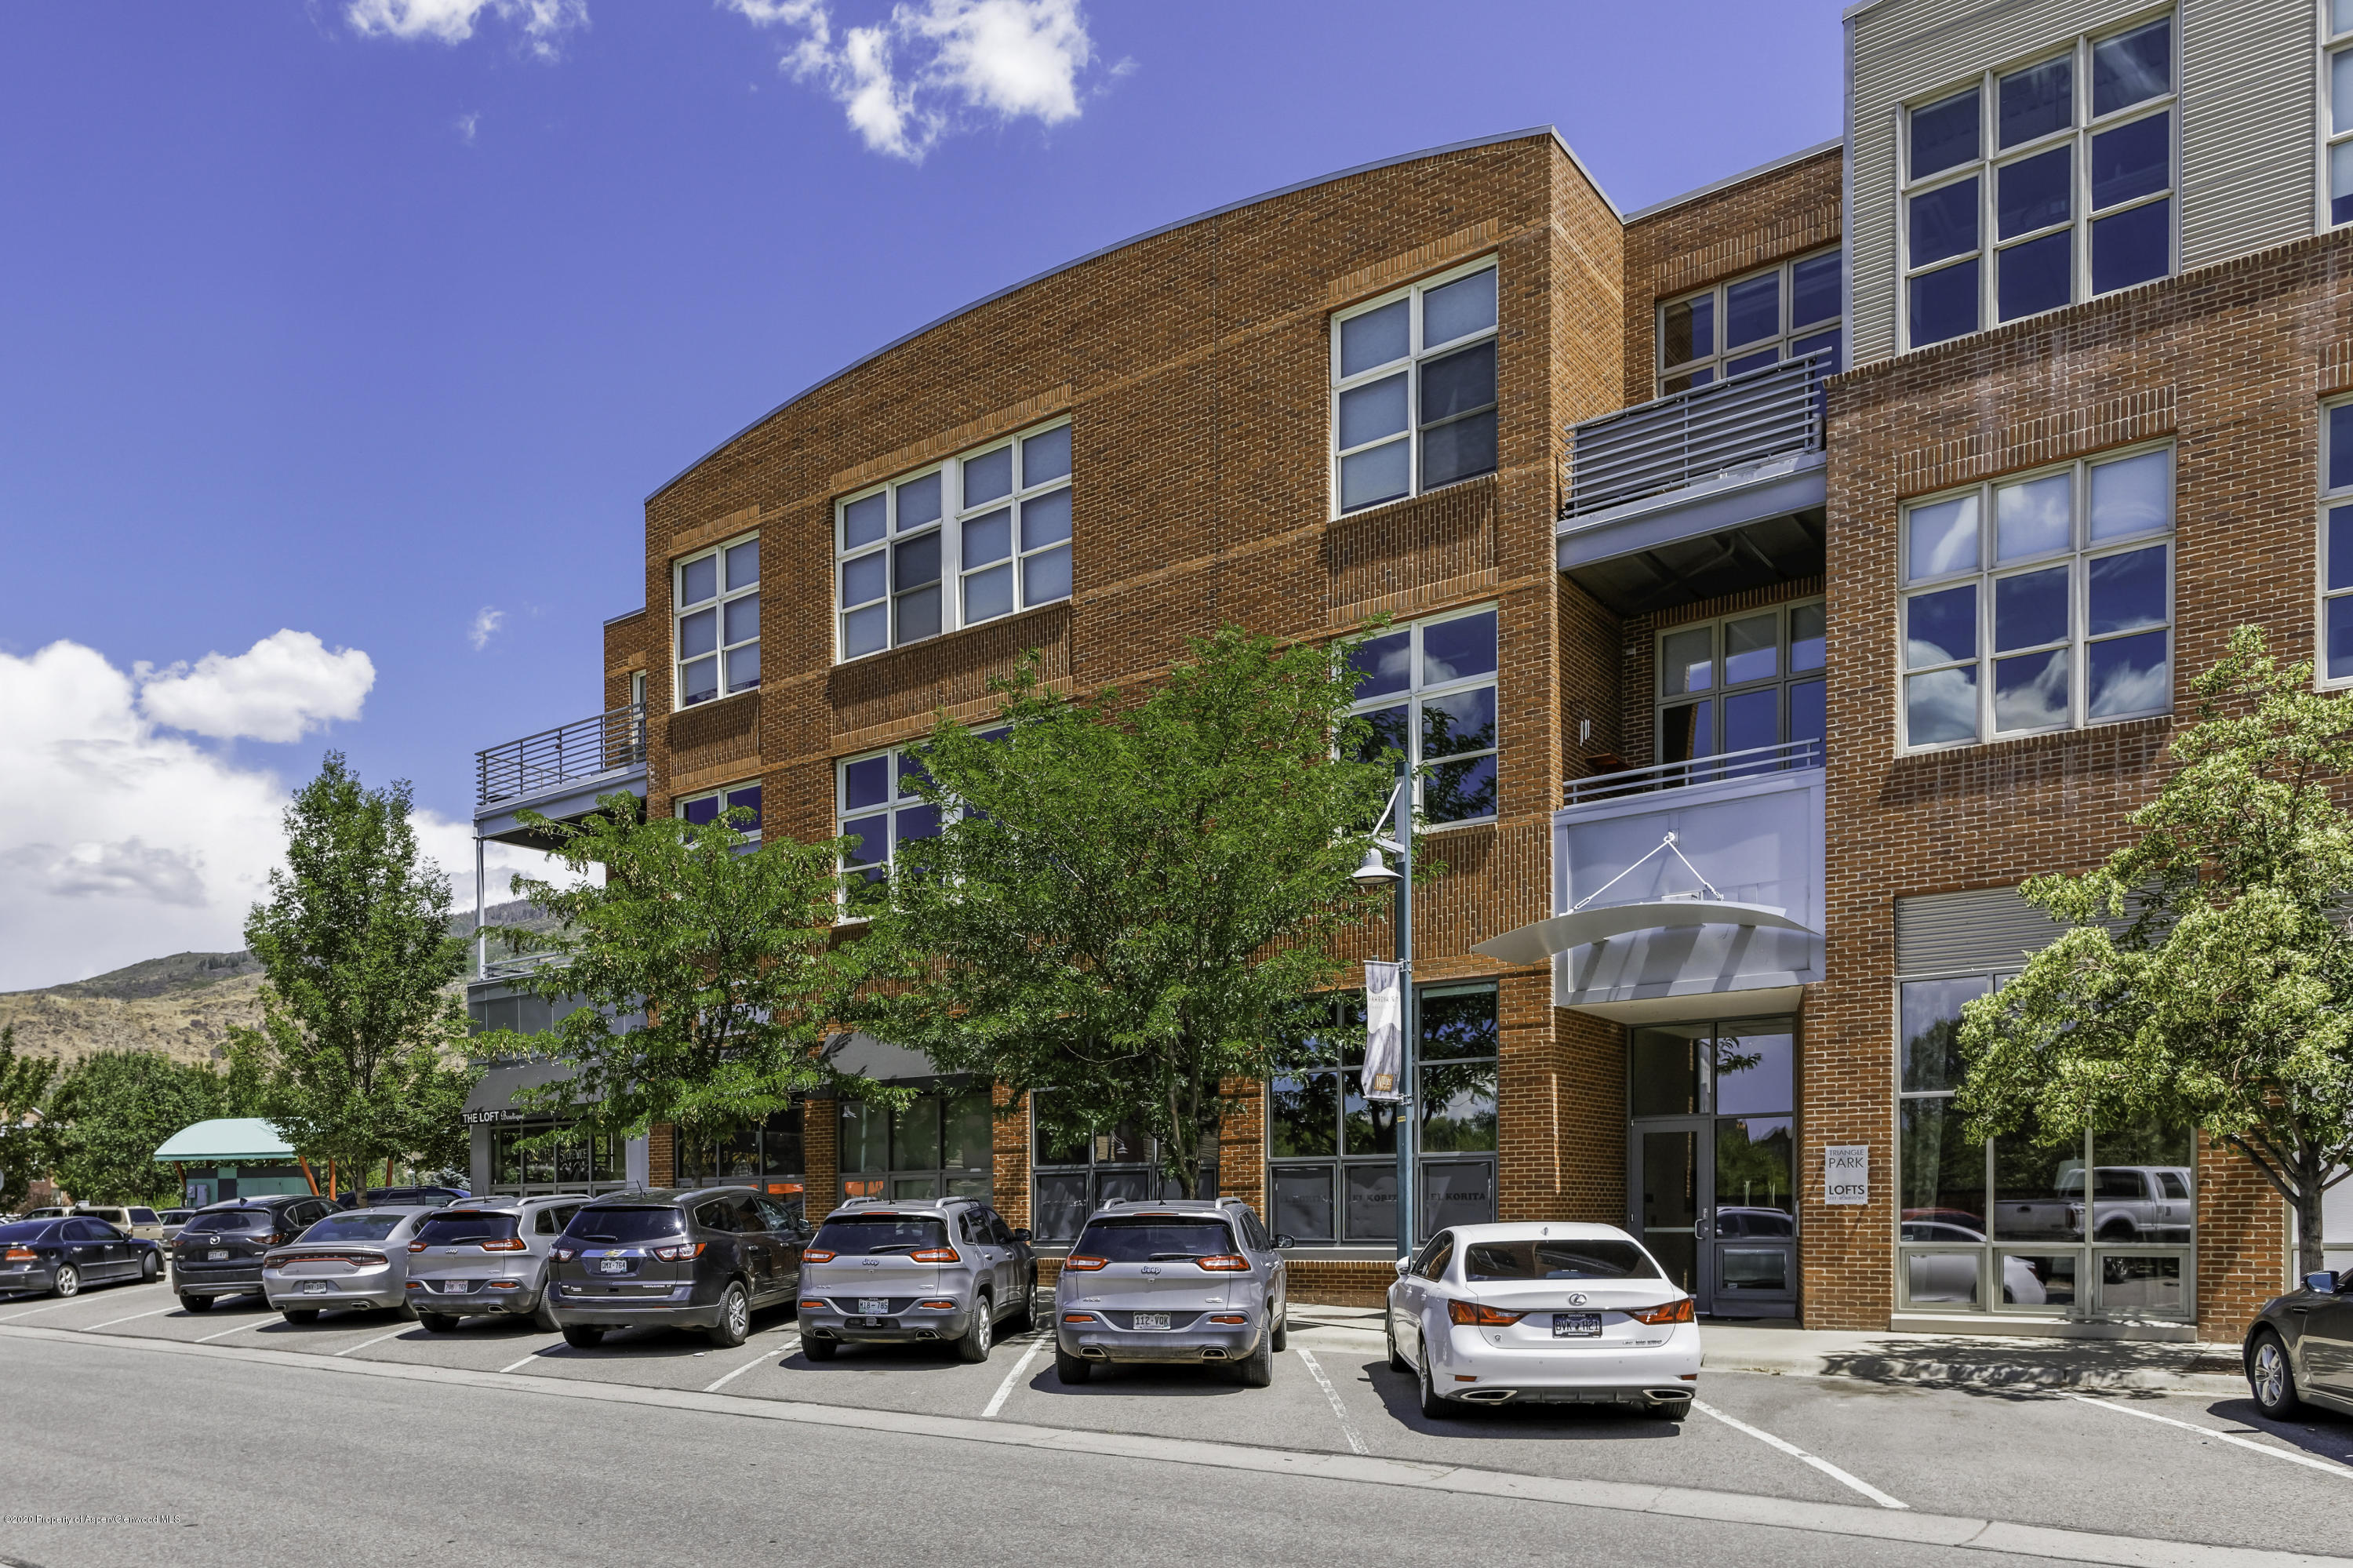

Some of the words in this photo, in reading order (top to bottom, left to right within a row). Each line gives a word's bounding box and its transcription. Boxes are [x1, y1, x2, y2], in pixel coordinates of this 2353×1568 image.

[462, 1113, 478, 1123] THE
[479, 1111, 500, 1122] LOFT
[1828, 1157, 1864, 1169] PARK
[1828, 1184, 1865, 1195] LOFTS
[1431, 1192, 1443, 1201] EL
[1445, 1192, 1486, 1201] KORITA
[862, 1258, 880, 1267] Jeep
[1140, 1265, 1162, 1275] Jeep
[1556, 1320, 1572, 1331] BVK
[1583, 1320, 1599, 1330] H21
